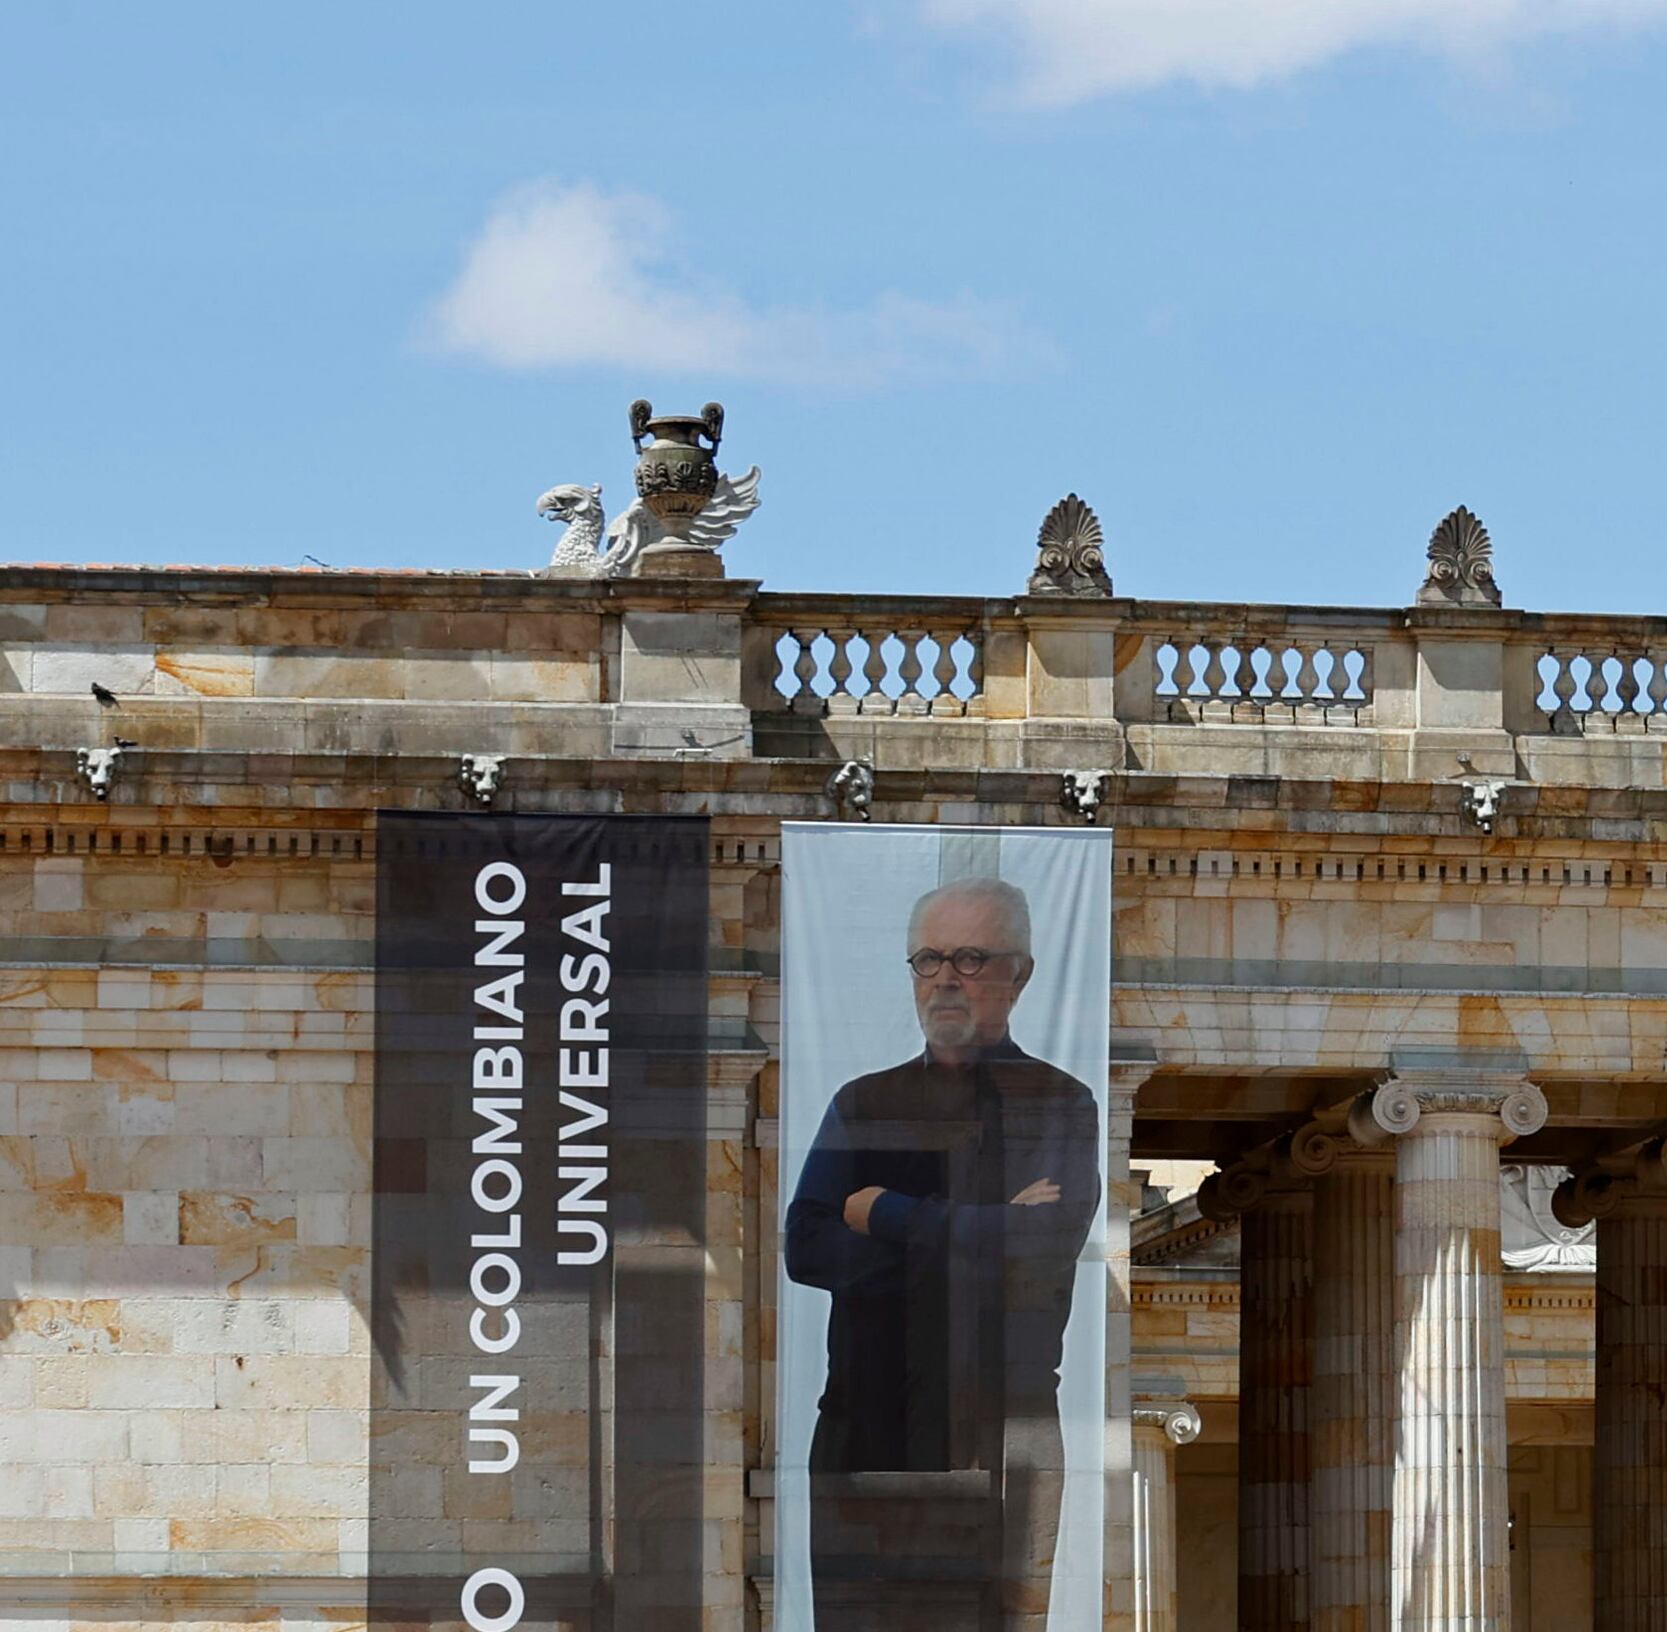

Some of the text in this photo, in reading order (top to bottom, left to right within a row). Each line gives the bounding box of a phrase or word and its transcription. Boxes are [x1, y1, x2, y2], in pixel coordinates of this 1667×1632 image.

[469, 861, 526, 1474] UN COLOMBIANO
[557, 862, 611, 1265] UNIVERSAL
